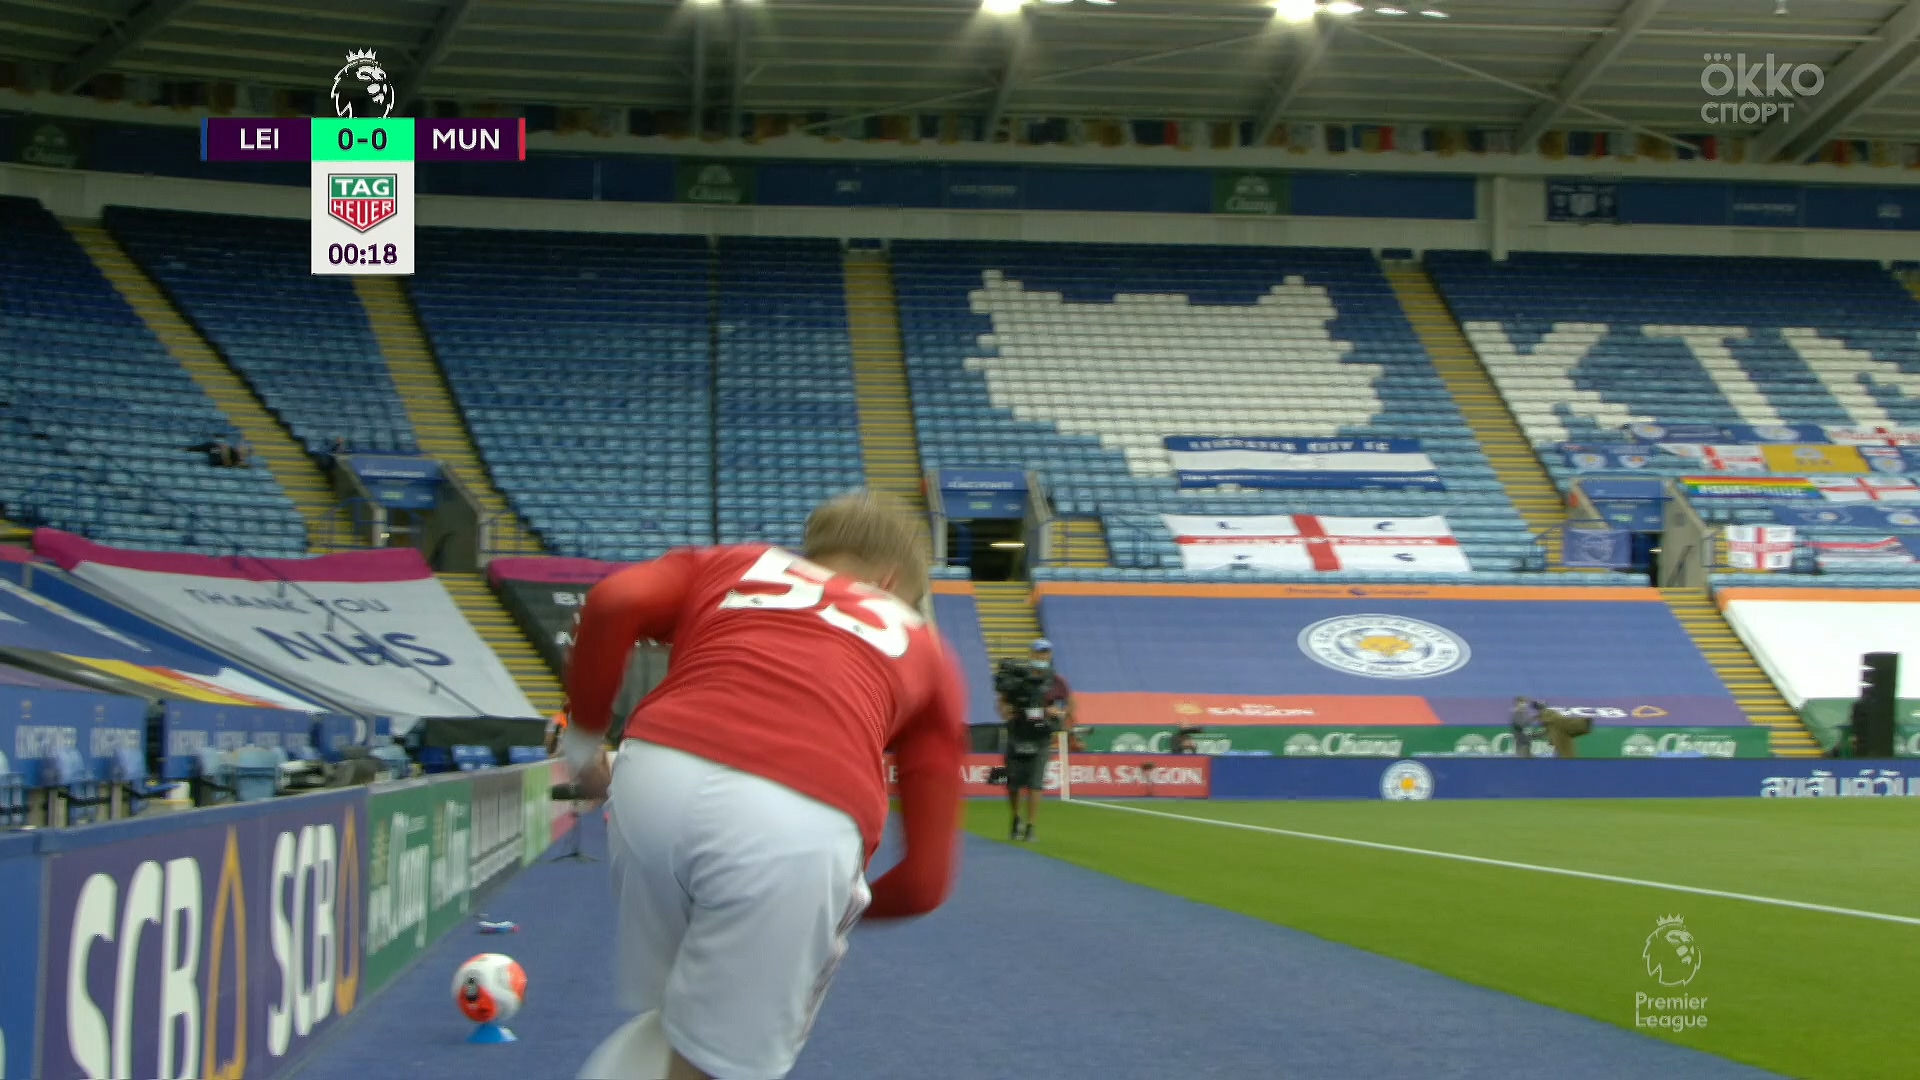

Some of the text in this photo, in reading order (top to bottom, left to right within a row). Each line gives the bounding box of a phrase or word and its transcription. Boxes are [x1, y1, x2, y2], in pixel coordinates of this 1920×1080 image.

[184, 588, 391, 615] THANK YOU
[718, 546, 925, 659] 53
[254, 626, 454, 669] NHS
[1319, 732, 1403, 757] Chang
[1114, 764, 1203, 785] SAGON
[267, 823, 337, 1057] SCB
[67, 857, 203, 1080] SCB
